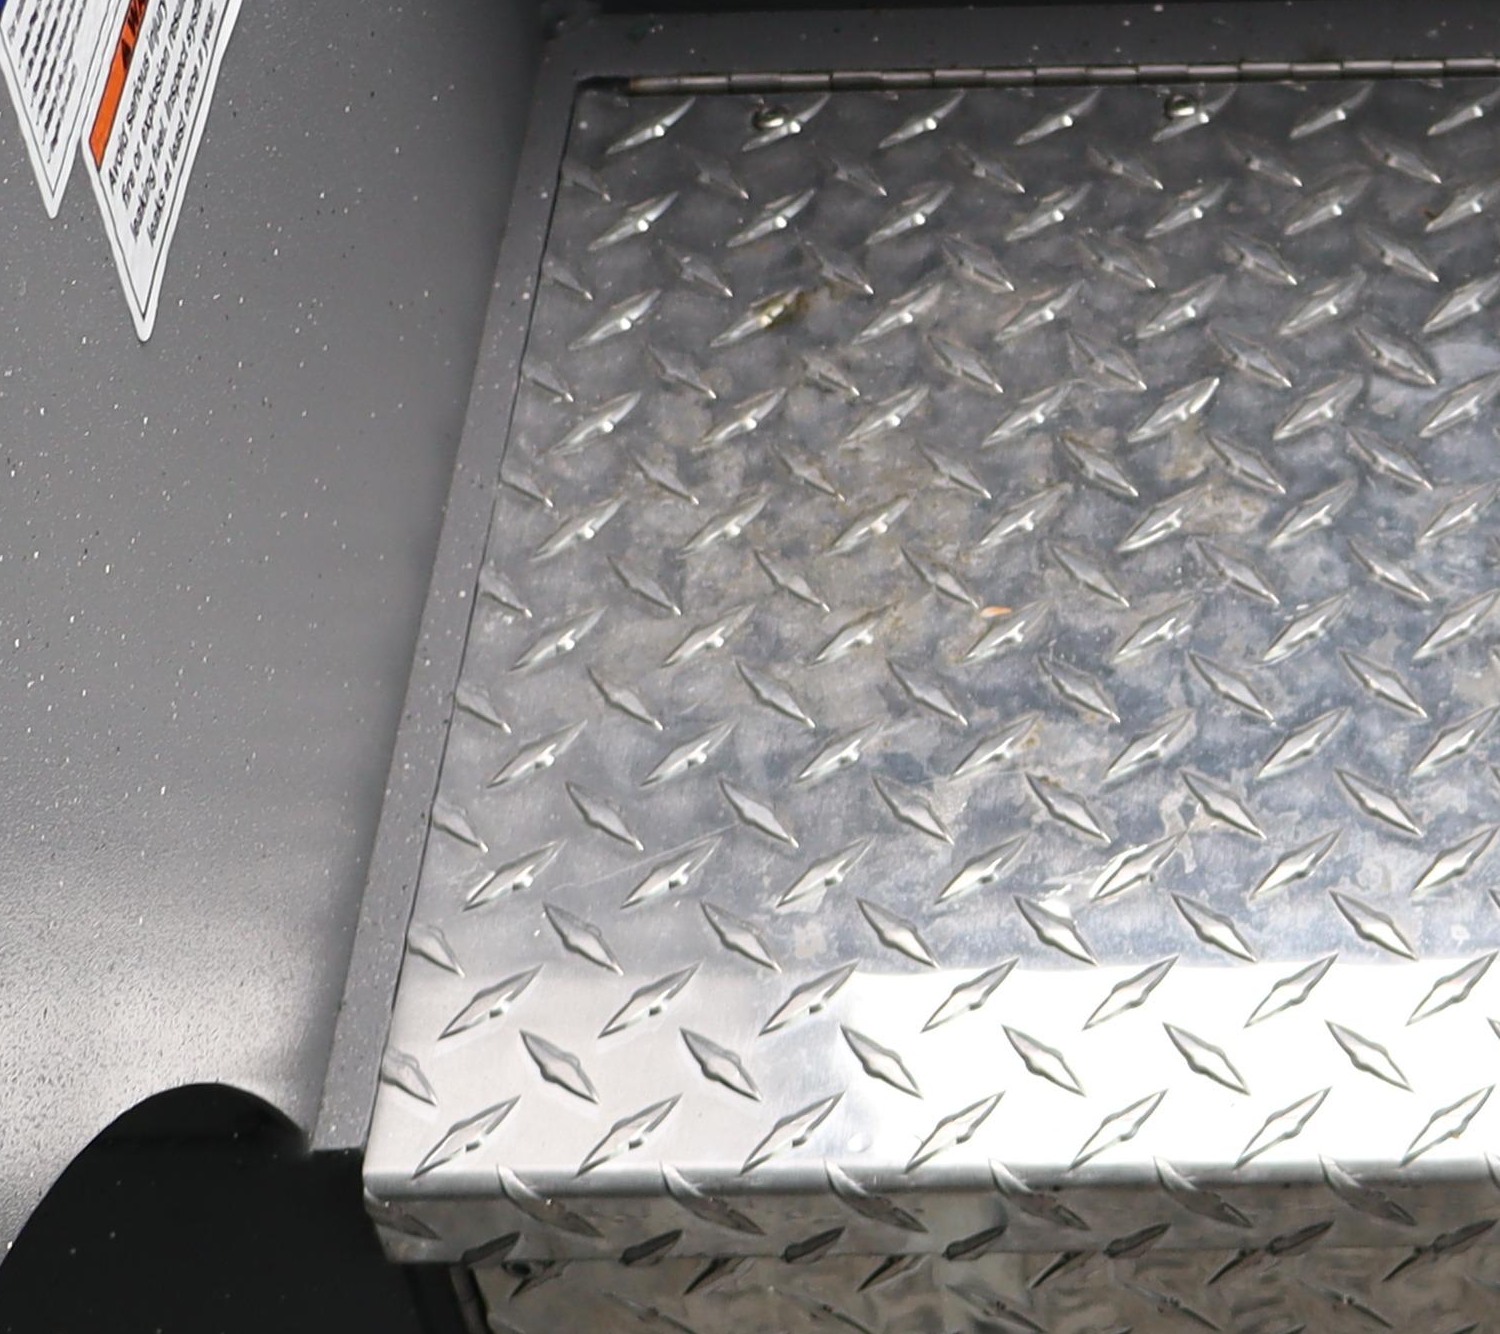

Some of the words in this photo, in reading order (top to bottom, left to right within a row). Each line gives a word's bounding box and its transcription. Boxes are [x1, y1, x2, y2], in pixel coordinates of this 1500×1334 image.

[107, 123, 128, 193] Avoid
[125, 48, 149, 133] serious
[121, 162, 135, 210] fire
[132, 141, 143, 174] or
[139, 40, 171, 151] explosion
[130, 158, 155, 247] leaking
[164, 39, 188, 124] Inspect
[146, 183, 165, 248] leaks
[161, 160, 172, 192] at
[168, 109, 185, 168] least
[183, 60, 198, 115] once
